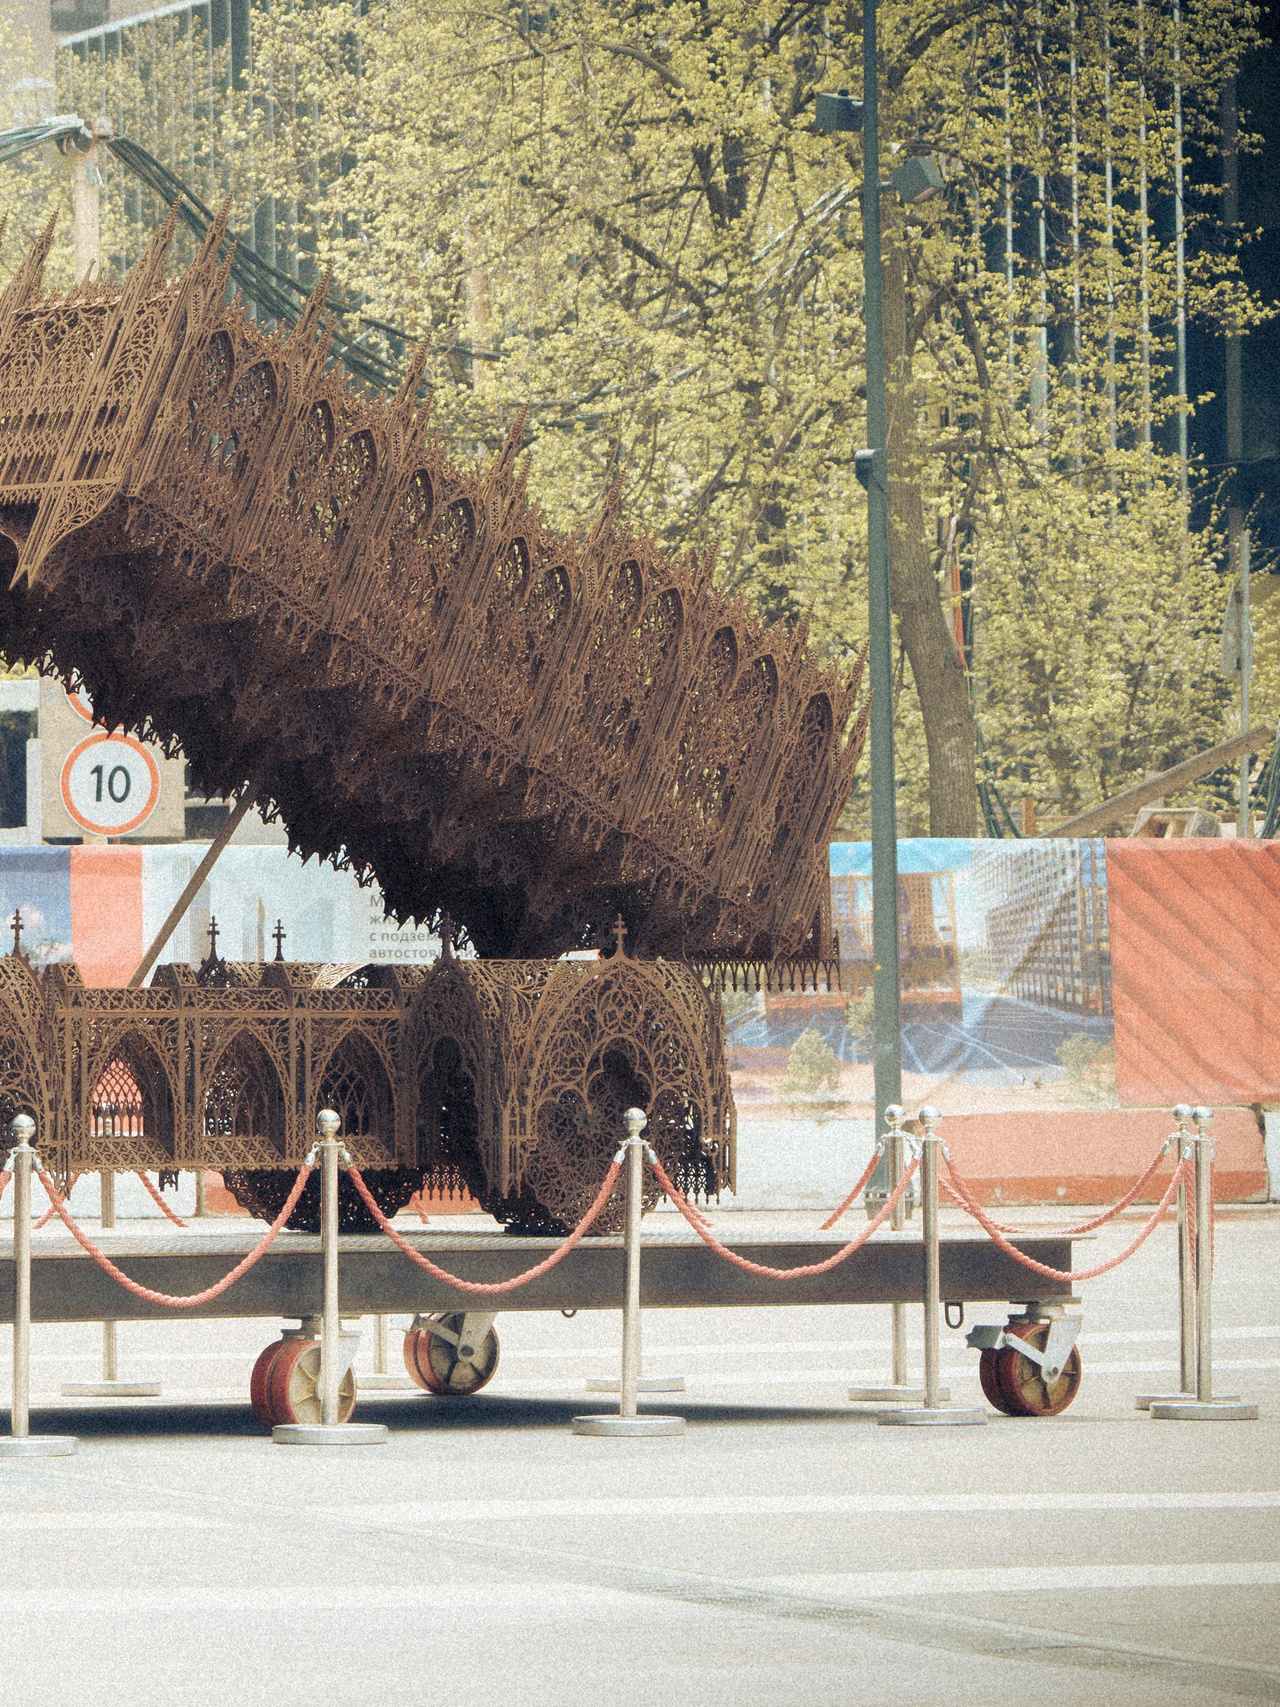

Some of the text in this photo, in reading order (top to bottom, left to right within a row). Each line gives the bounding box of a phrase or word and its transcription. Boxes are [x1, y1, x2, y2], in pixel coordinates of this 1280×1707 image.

[90, 764, 131, 803] 10
[369, 932, 440, 943] с подзем
[369, 946, 474, 959] автостояой
